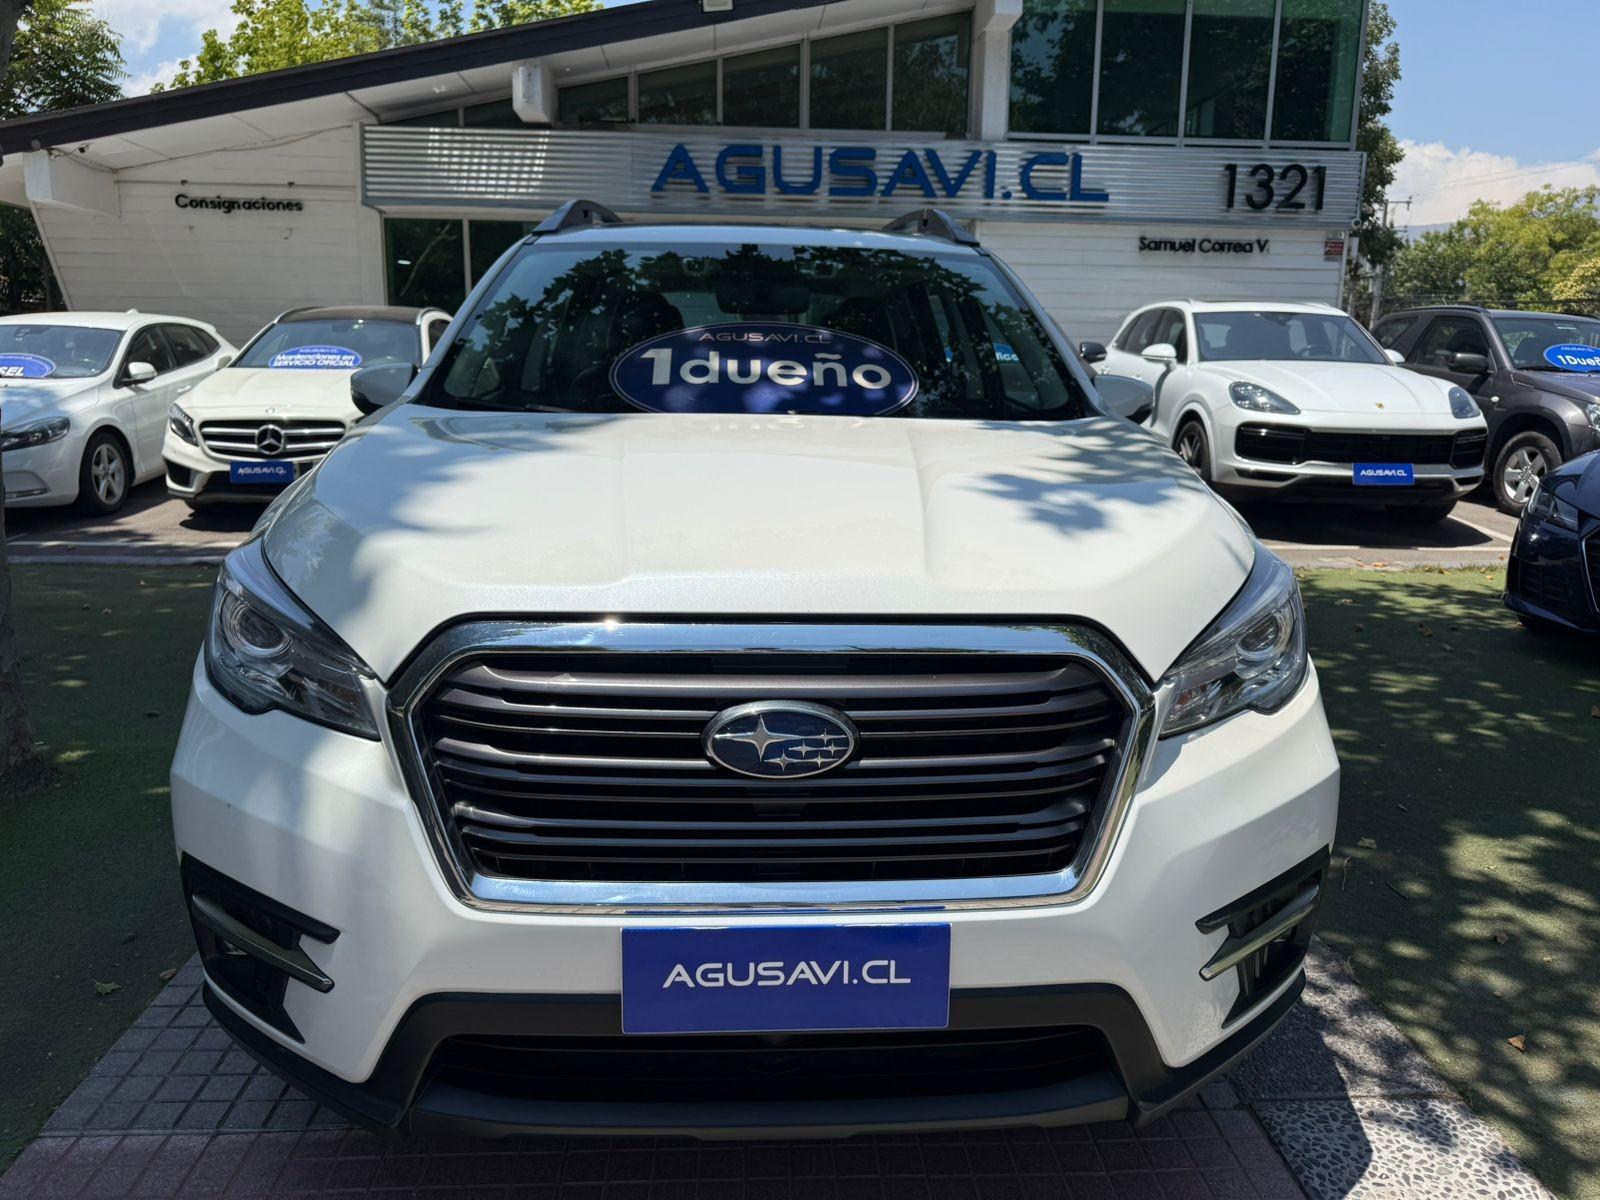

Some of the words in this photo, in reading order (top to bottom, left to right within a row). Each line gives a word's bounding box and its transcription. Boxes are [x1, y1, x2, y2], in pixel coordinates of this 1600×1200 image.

[650, 143, 1109, 201] AGUSAVI.CL
[1224, 163, 1327, 211] 1321
[174, 193, 303, 214] Consignaciones
[1139, 237, 1196, 253] Samuel
[1199, 238, 1254, 254] Correa
[699, 331, 831, 345] AGUSAVI.CL
[662, 959, 912, 989] AGUSAVI.CL
